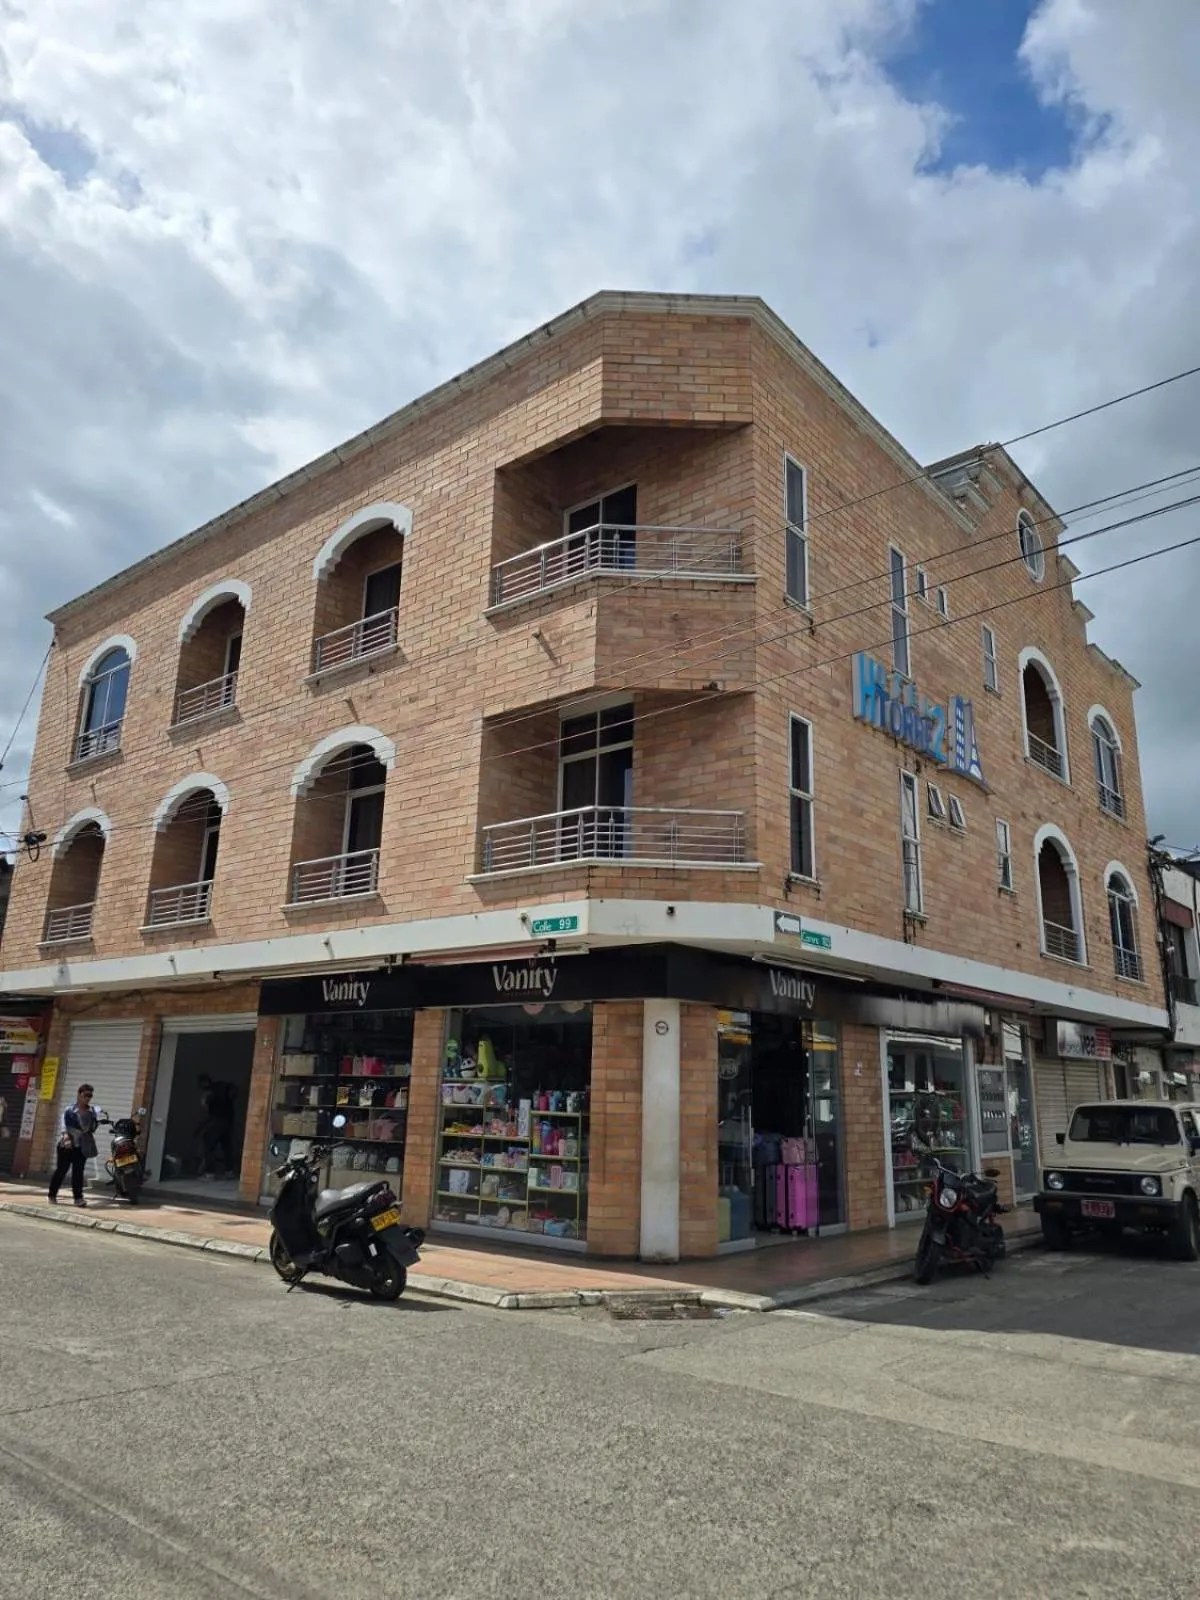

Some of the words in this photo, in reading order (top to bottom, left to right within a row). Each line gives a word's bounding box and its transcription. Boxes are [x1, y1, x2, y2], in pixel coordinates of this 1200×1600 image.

[533, 920, 553, 933] Calle
[559, 917, 572, 930] 99
[322, 977, 370, 1007] Vanity
[492, 962, 558, 997] Vanity
[769, 969, 816, 1009] Vanity
